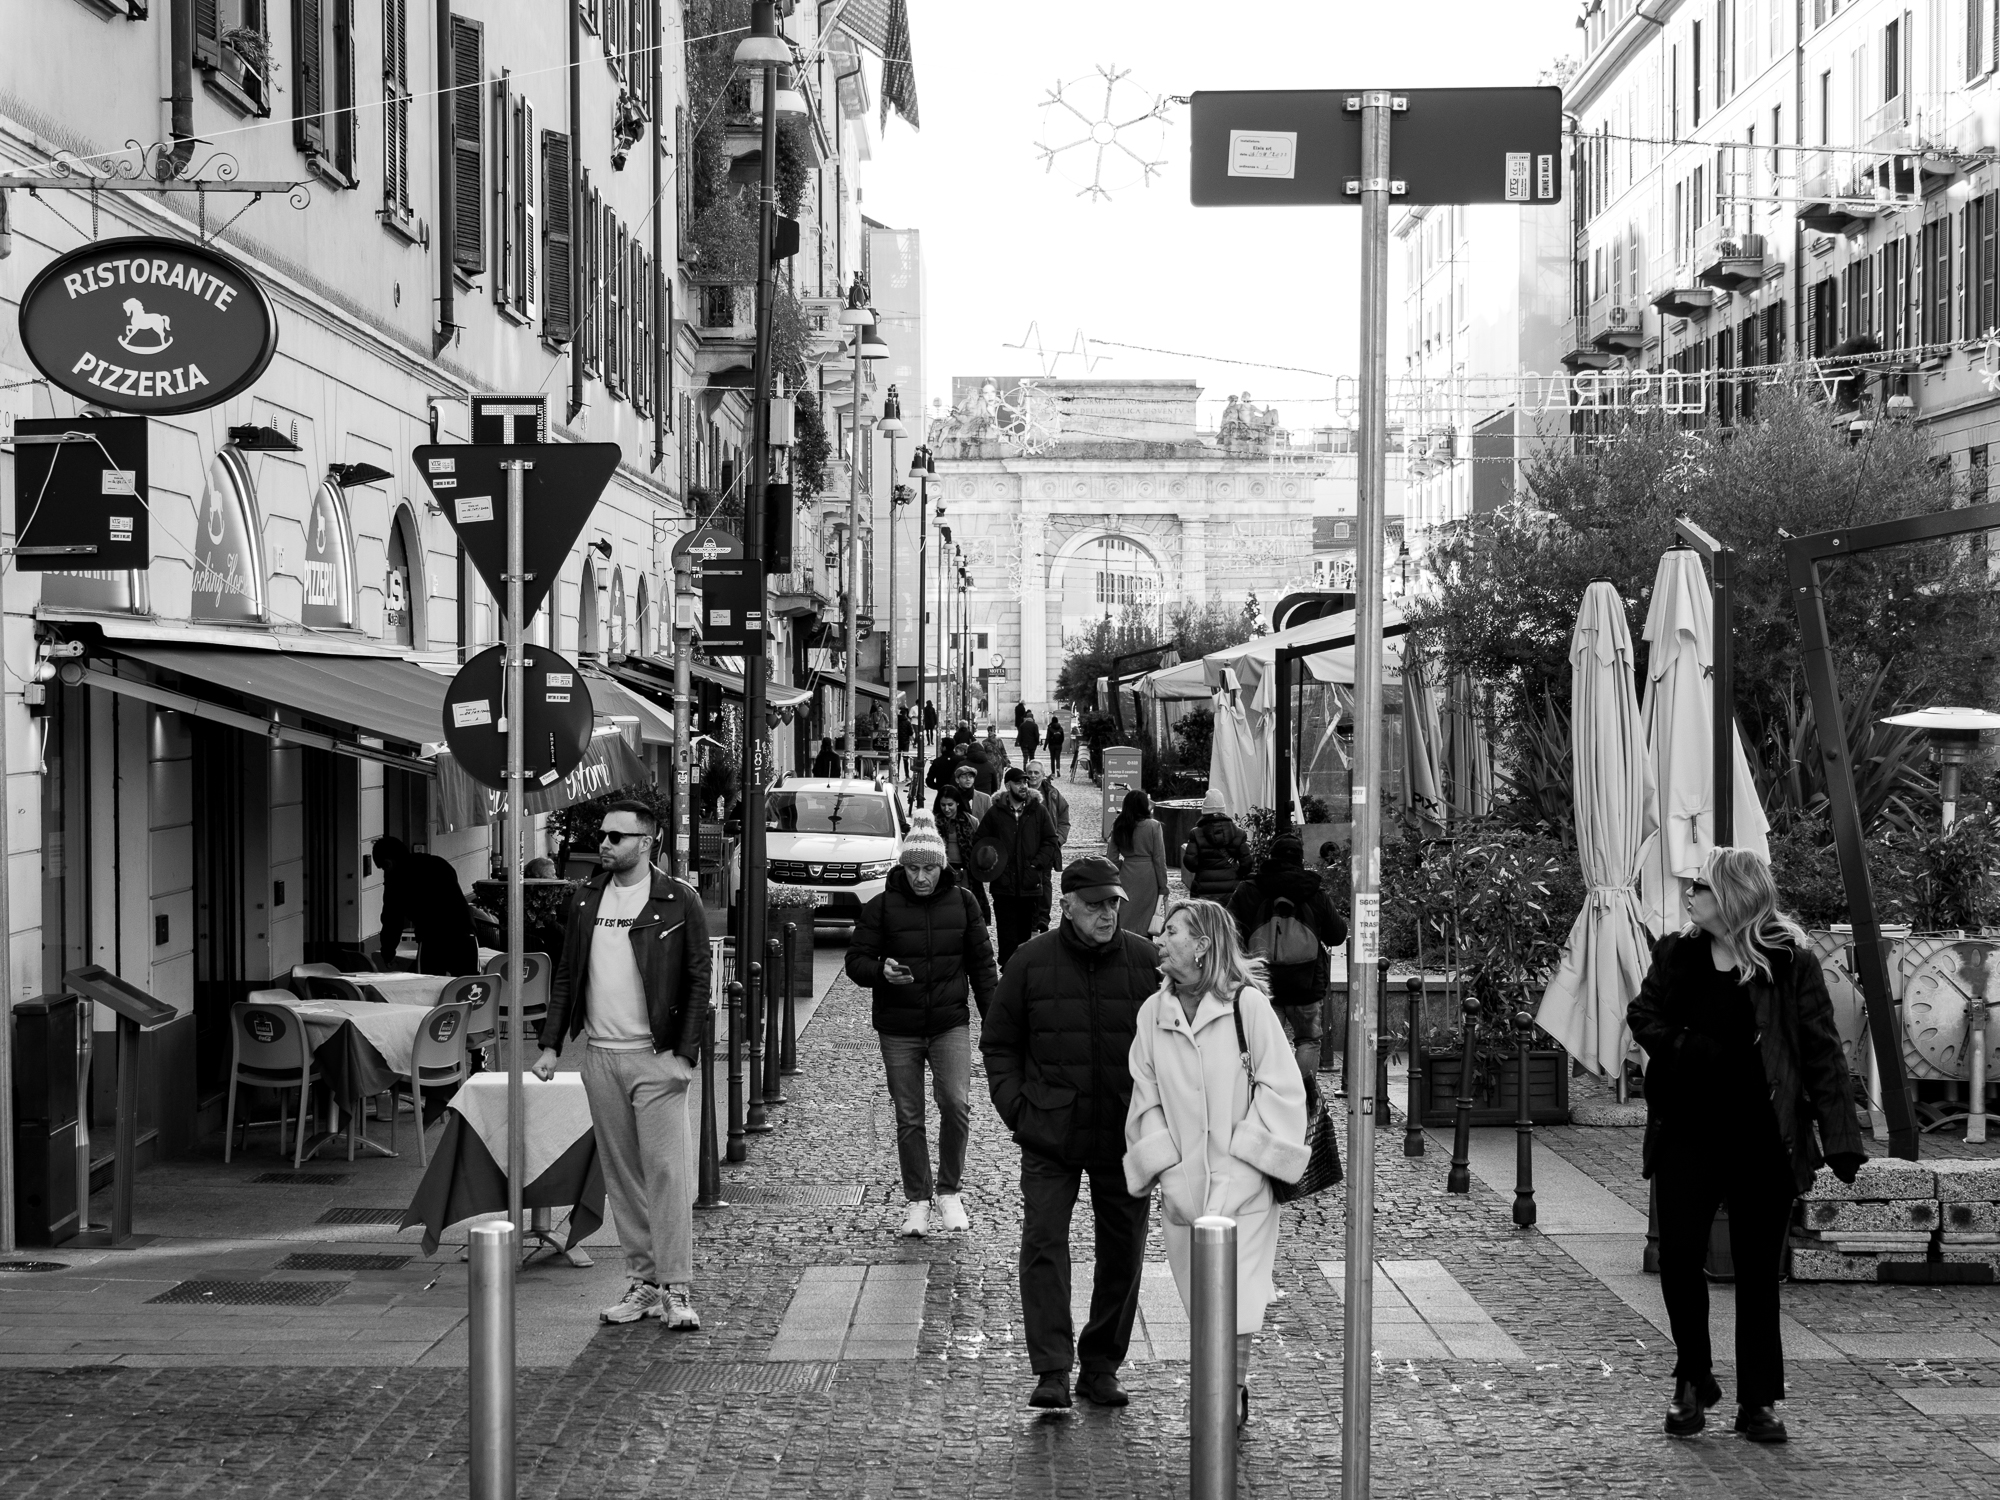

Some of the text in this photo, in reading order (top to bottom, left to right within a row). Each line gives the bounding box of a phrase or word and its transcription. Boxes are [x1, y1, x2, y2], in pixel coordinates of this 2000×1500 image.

[63, 258, 238, 312] RISTORANTE
[71, 351, 210, 397] PIZZERIA
[303, 559, 337, 606] PIZZERIA
